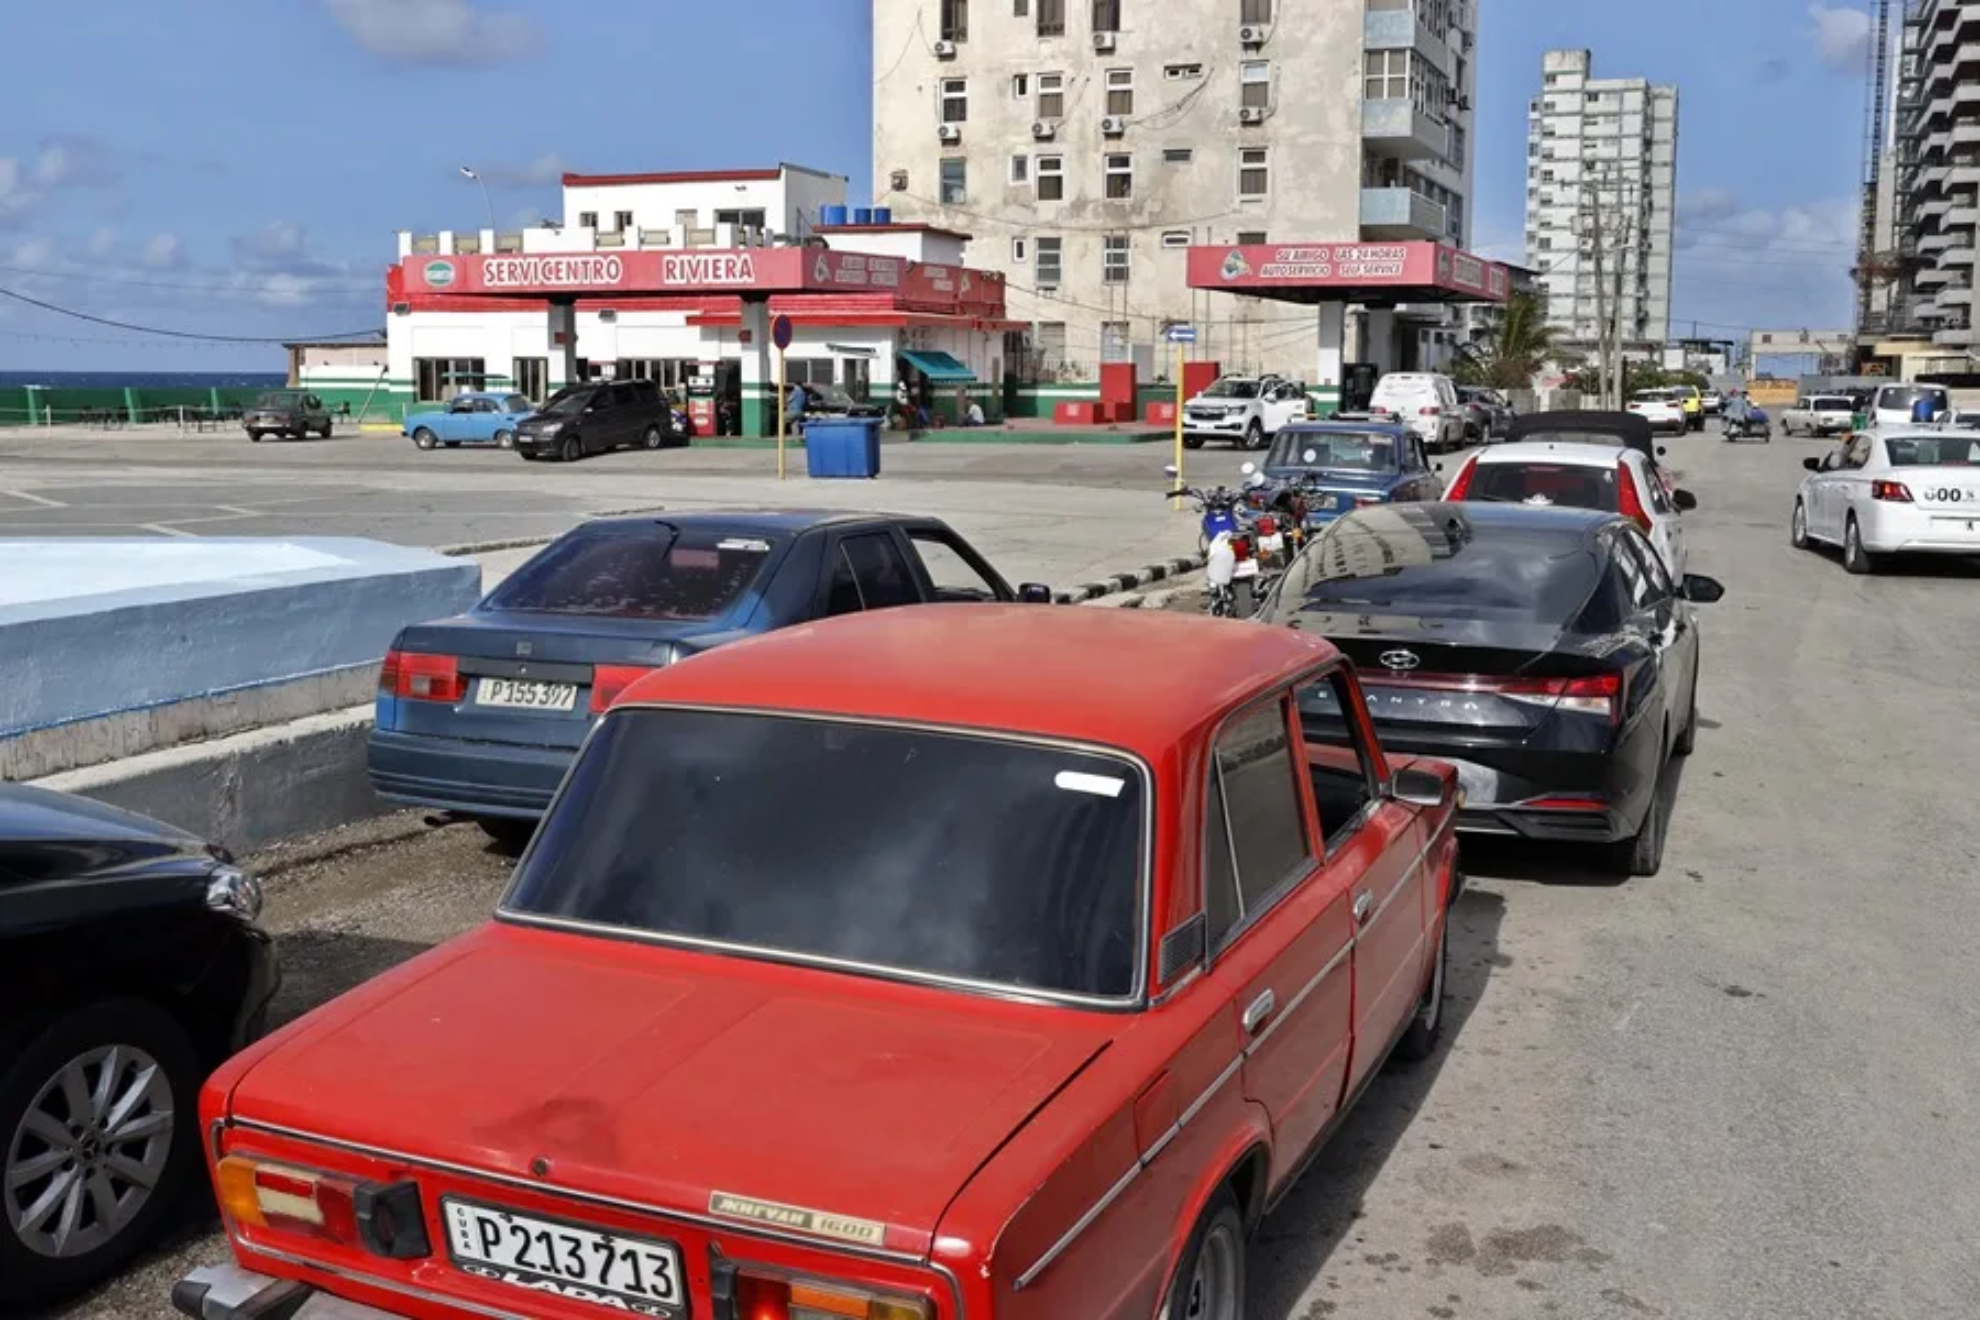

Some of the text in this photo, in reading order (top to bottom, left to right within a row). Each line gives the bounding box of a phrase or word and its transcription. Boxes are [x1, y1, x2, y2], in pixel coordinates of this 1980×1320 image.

[484, 254, 755, 286] SERVICENTRO RIVIERA
[1318, 690, 1479, 711] EANTRA
[457, 1207, 471, 1250] CUBA
[820, 1218, 874, 1238] 1600
